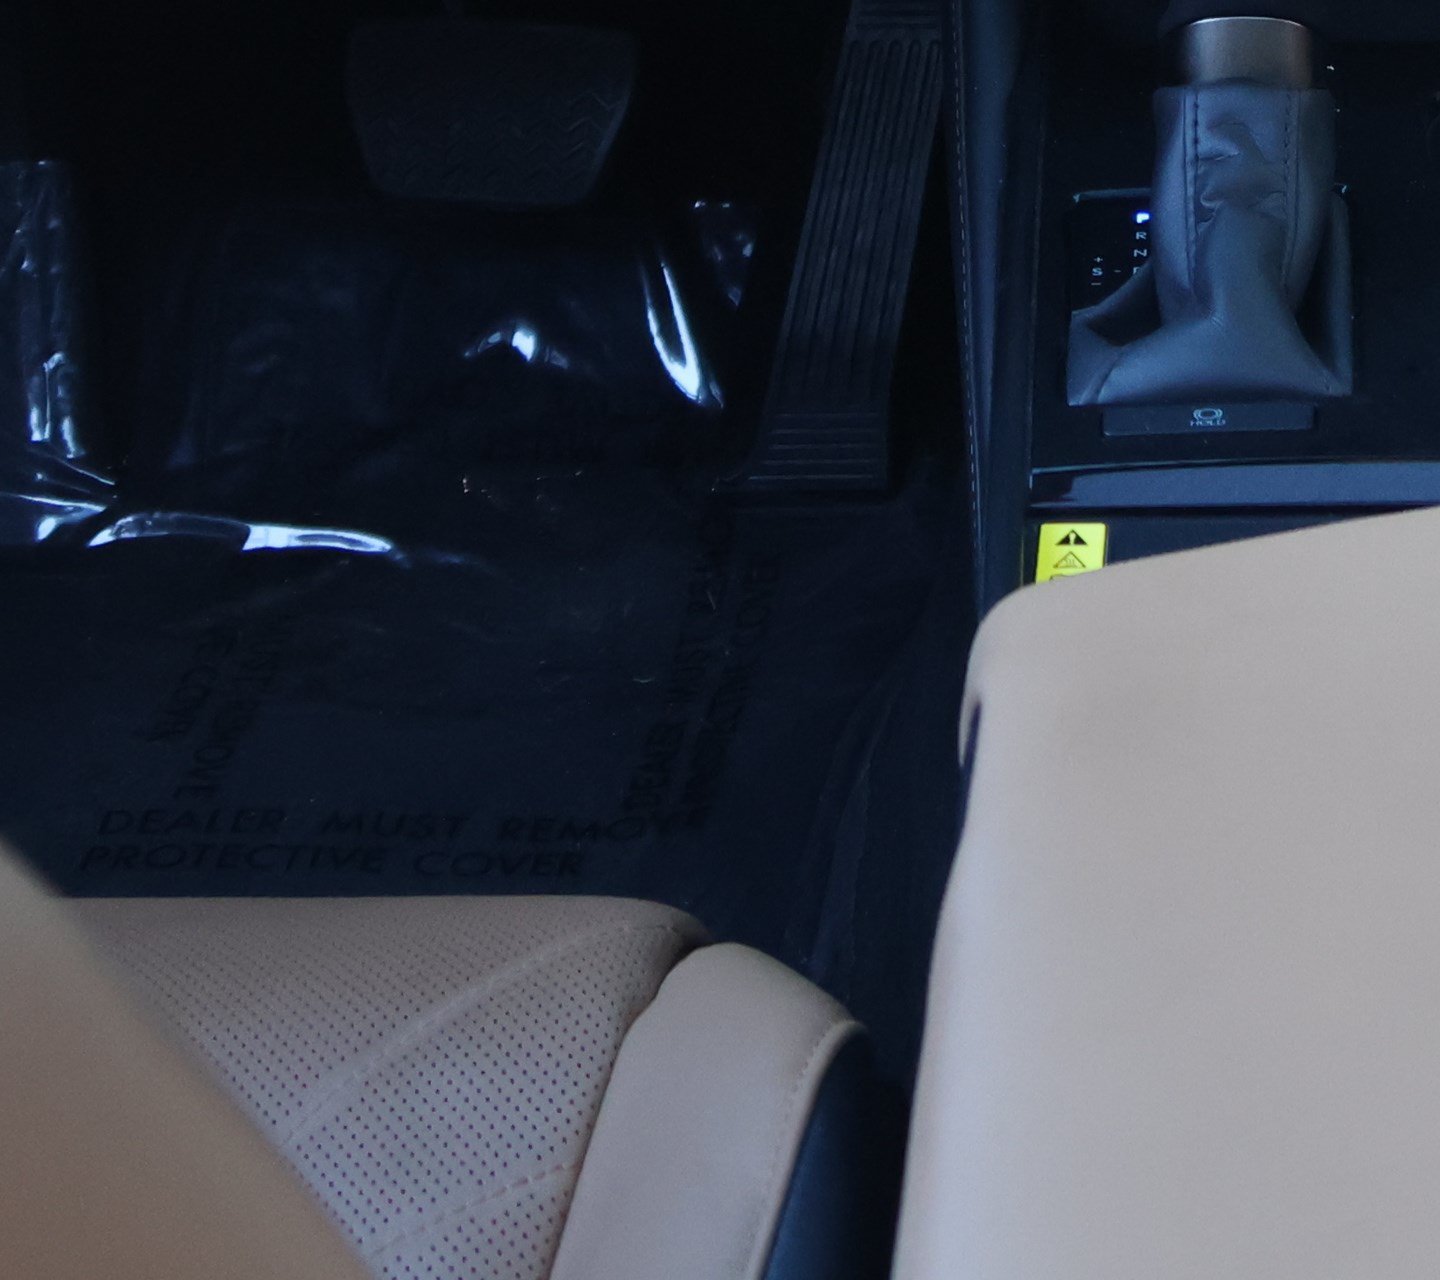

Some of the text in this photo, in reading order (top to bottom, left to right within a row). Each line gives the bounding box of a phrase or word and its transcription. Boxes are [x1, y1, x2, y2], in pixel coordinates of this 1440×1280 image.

[1136, 212, 1150, 224] P
[1135, 231, 1147, 240] R
[1133, 248, 1147, 257] N
[1091, 267, 1103, 276] S
[97, 808, 285, 838] DEALER
[322, 812, 469, 842] MUST
[79, 843, 584, 879] PROTECTIVE COVER
